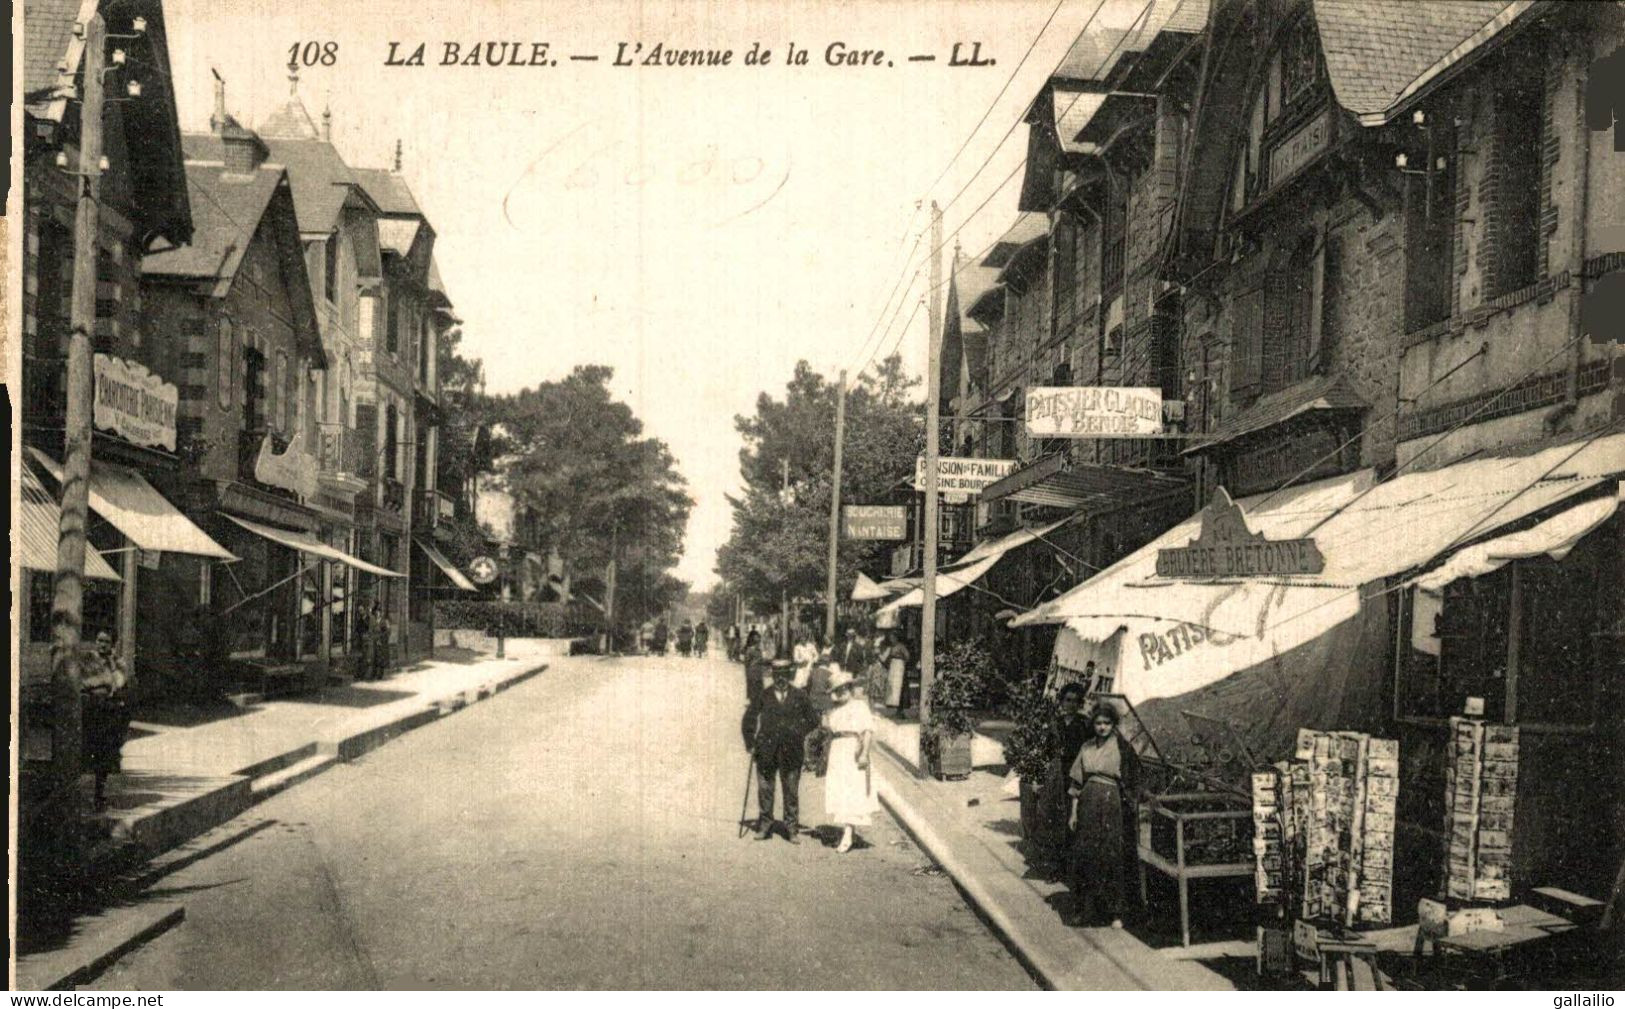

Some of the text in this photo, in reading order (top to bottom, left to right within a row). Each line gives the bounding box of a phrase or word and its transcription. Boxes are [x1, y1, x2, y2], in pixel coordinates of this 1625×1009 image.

[920, 460, 963, 475] PNSION
[971, 463, 1013, 477] FAMILL
[920, 477, 956, 488] CSINE
[847, 524, 901, 538] NANTAISE
[1226, 543, 1309, 573] BRETONNE
